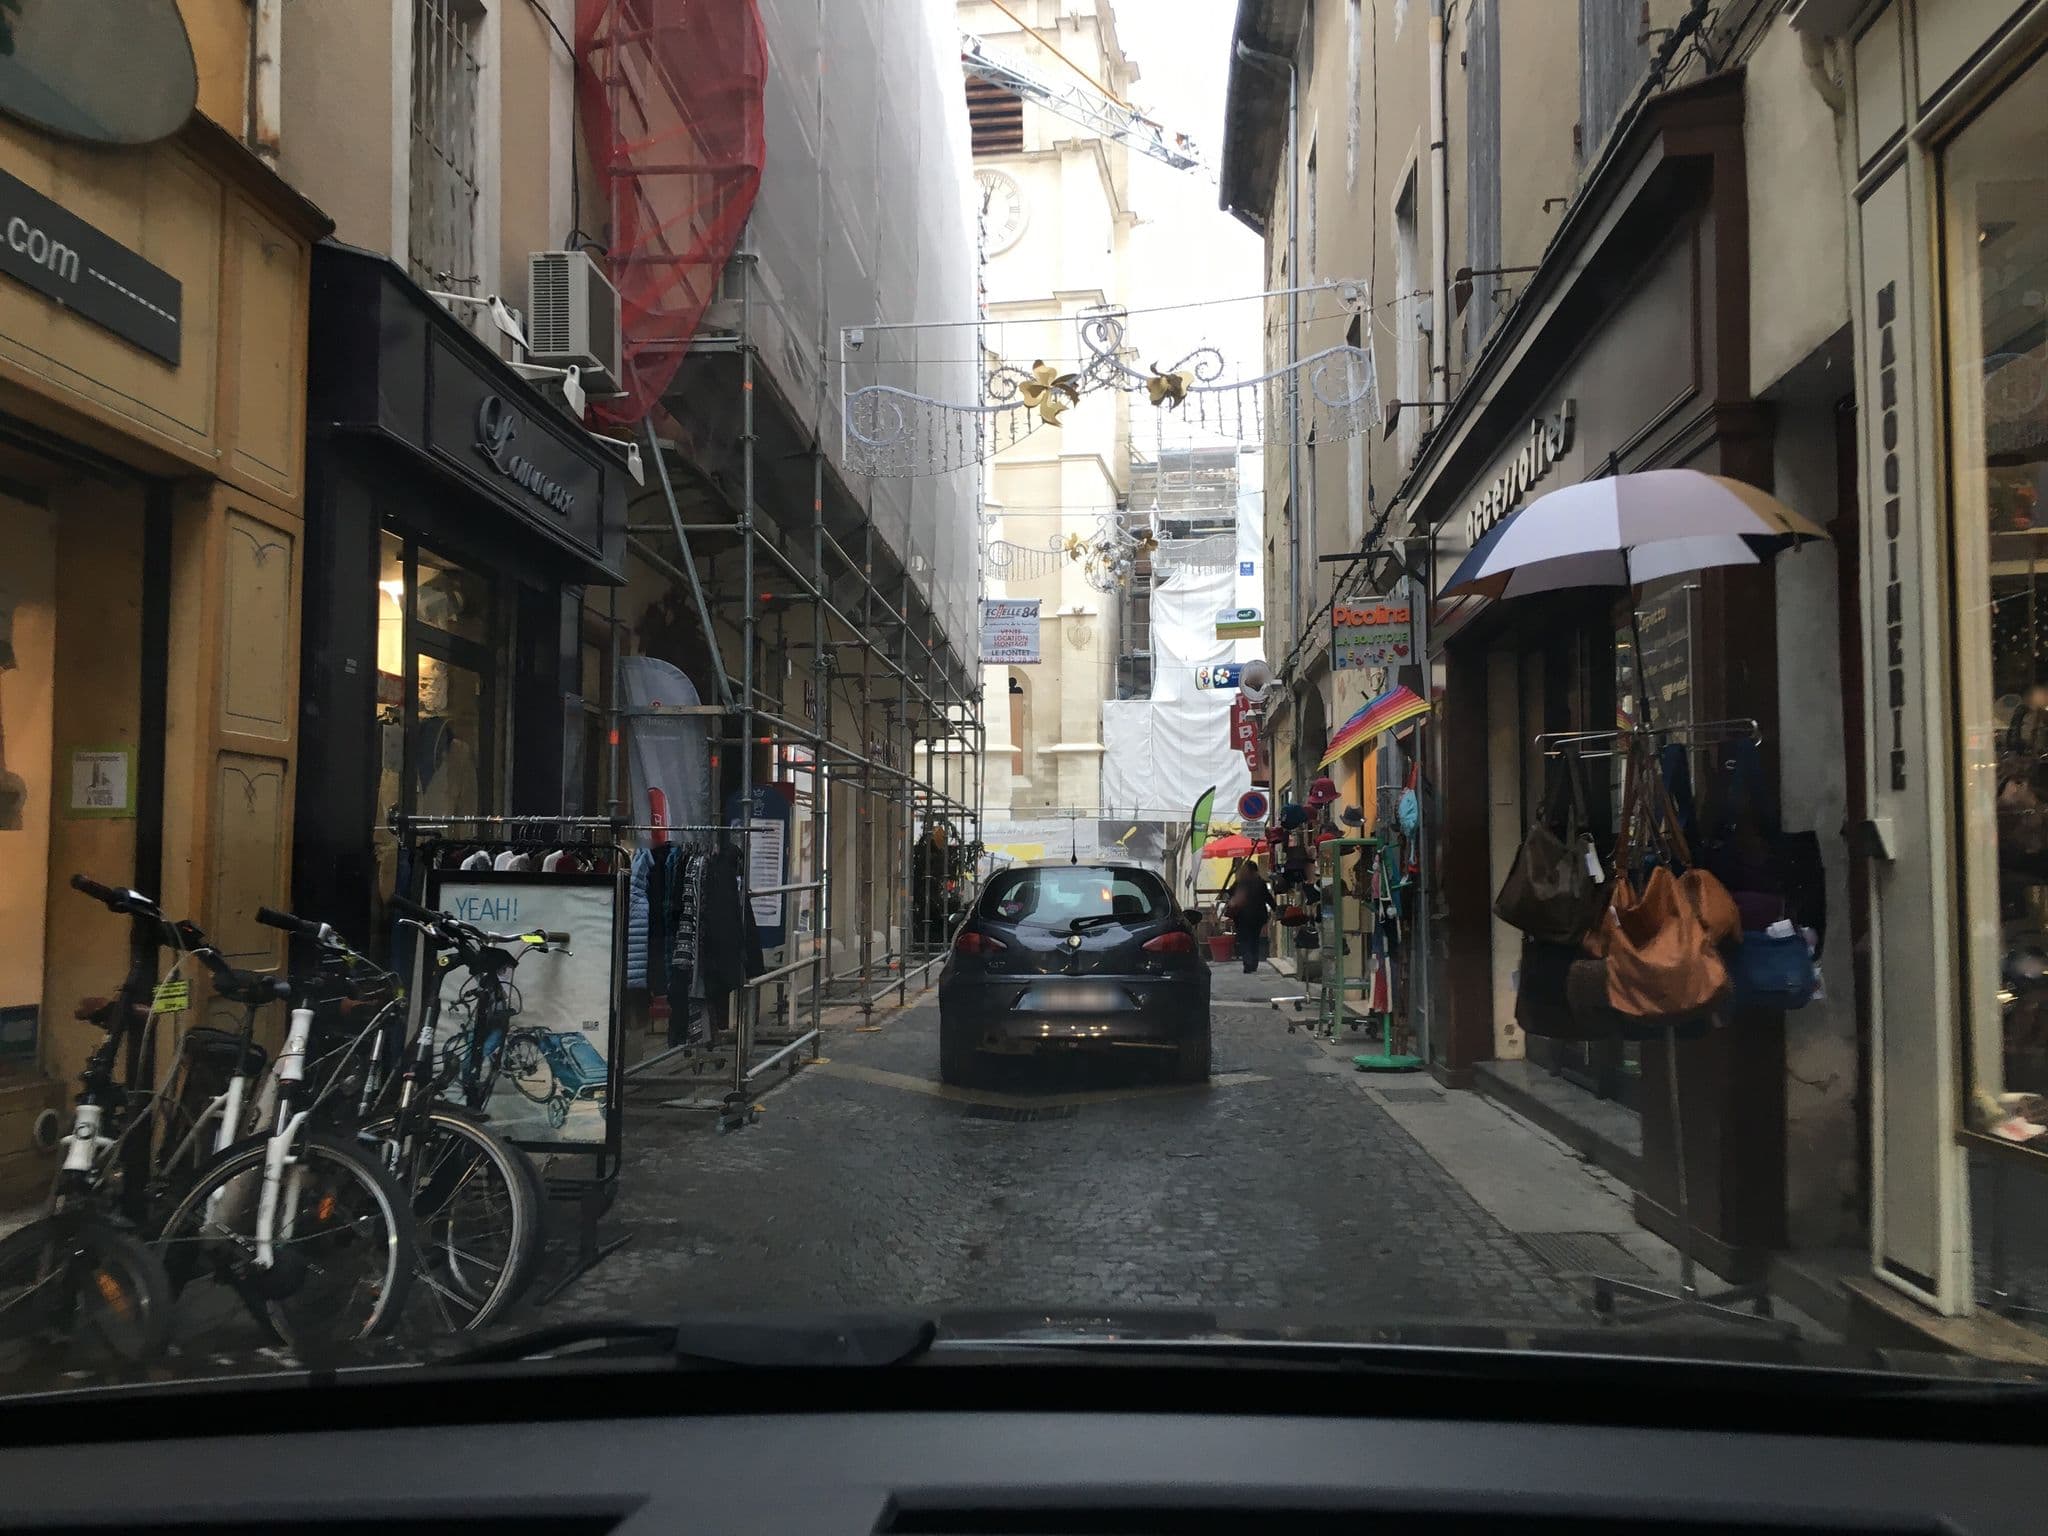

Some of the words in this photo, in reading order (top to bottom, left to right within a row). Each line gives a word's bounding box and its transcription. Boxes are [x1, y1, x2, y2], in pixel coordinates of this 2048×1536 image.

[1465, 399, 1573, 549] accessoires
[1876, 280, 1907, 791] MAROQUINERIE
[455, 897, 518, 922] YEAH!
